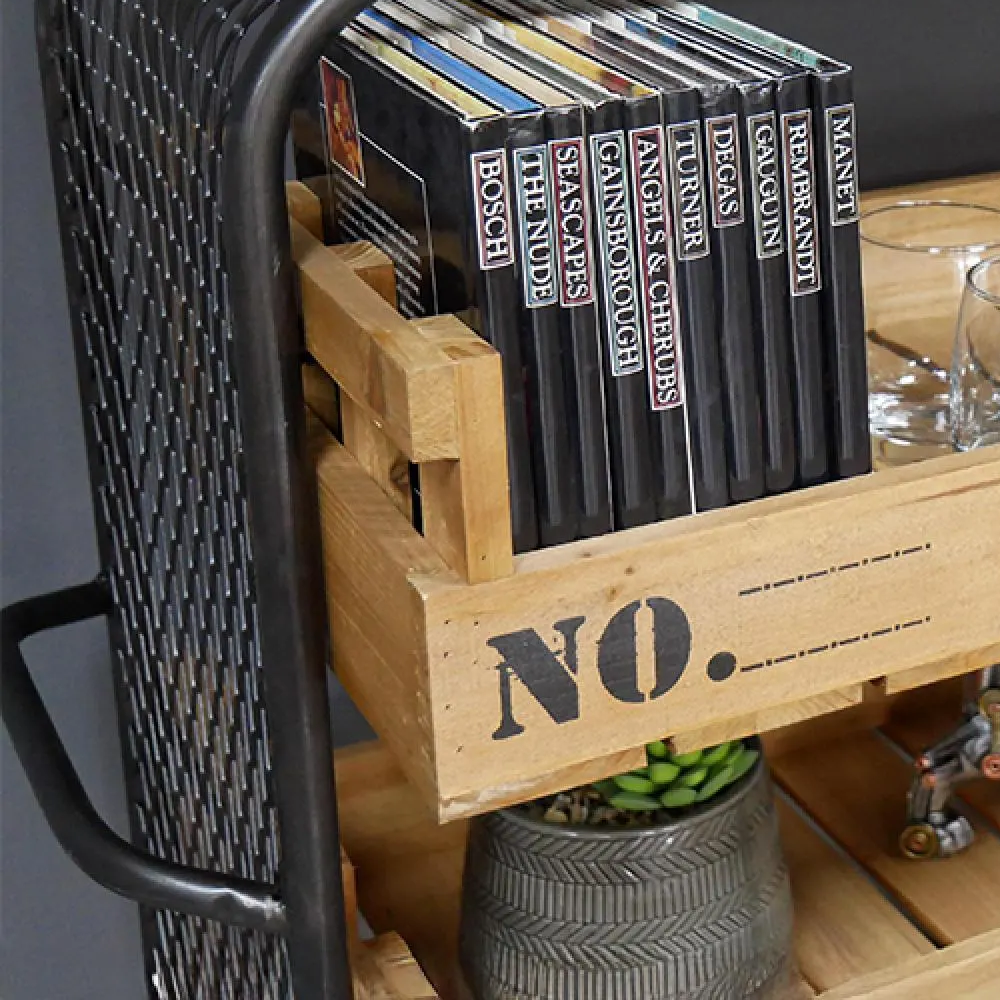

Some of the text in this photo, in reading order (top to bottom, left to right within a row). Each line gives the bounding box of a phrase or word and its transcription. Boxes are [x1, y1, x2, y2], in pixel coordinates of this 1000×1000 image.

[479, 157, 510, 260] BOSCH
[520, 153, 554, 301] THE NUDE
[556, 146, 589, 299] SEASCAPES
[675, 131, 702, 251] TURNER
[713, 125, 738, 216] DEGAS
[756, 124, 782, 248] GAUGUIN
[789, 123, 816, 285] REMBRANDT
[833, 115, 855, 214] MANET
[600, 141, 639, 368] GAINSBOROUGH
[638, 139, 678, 403] ANGELS & CHERUBS
[486, 596, 738, 741] NO.
